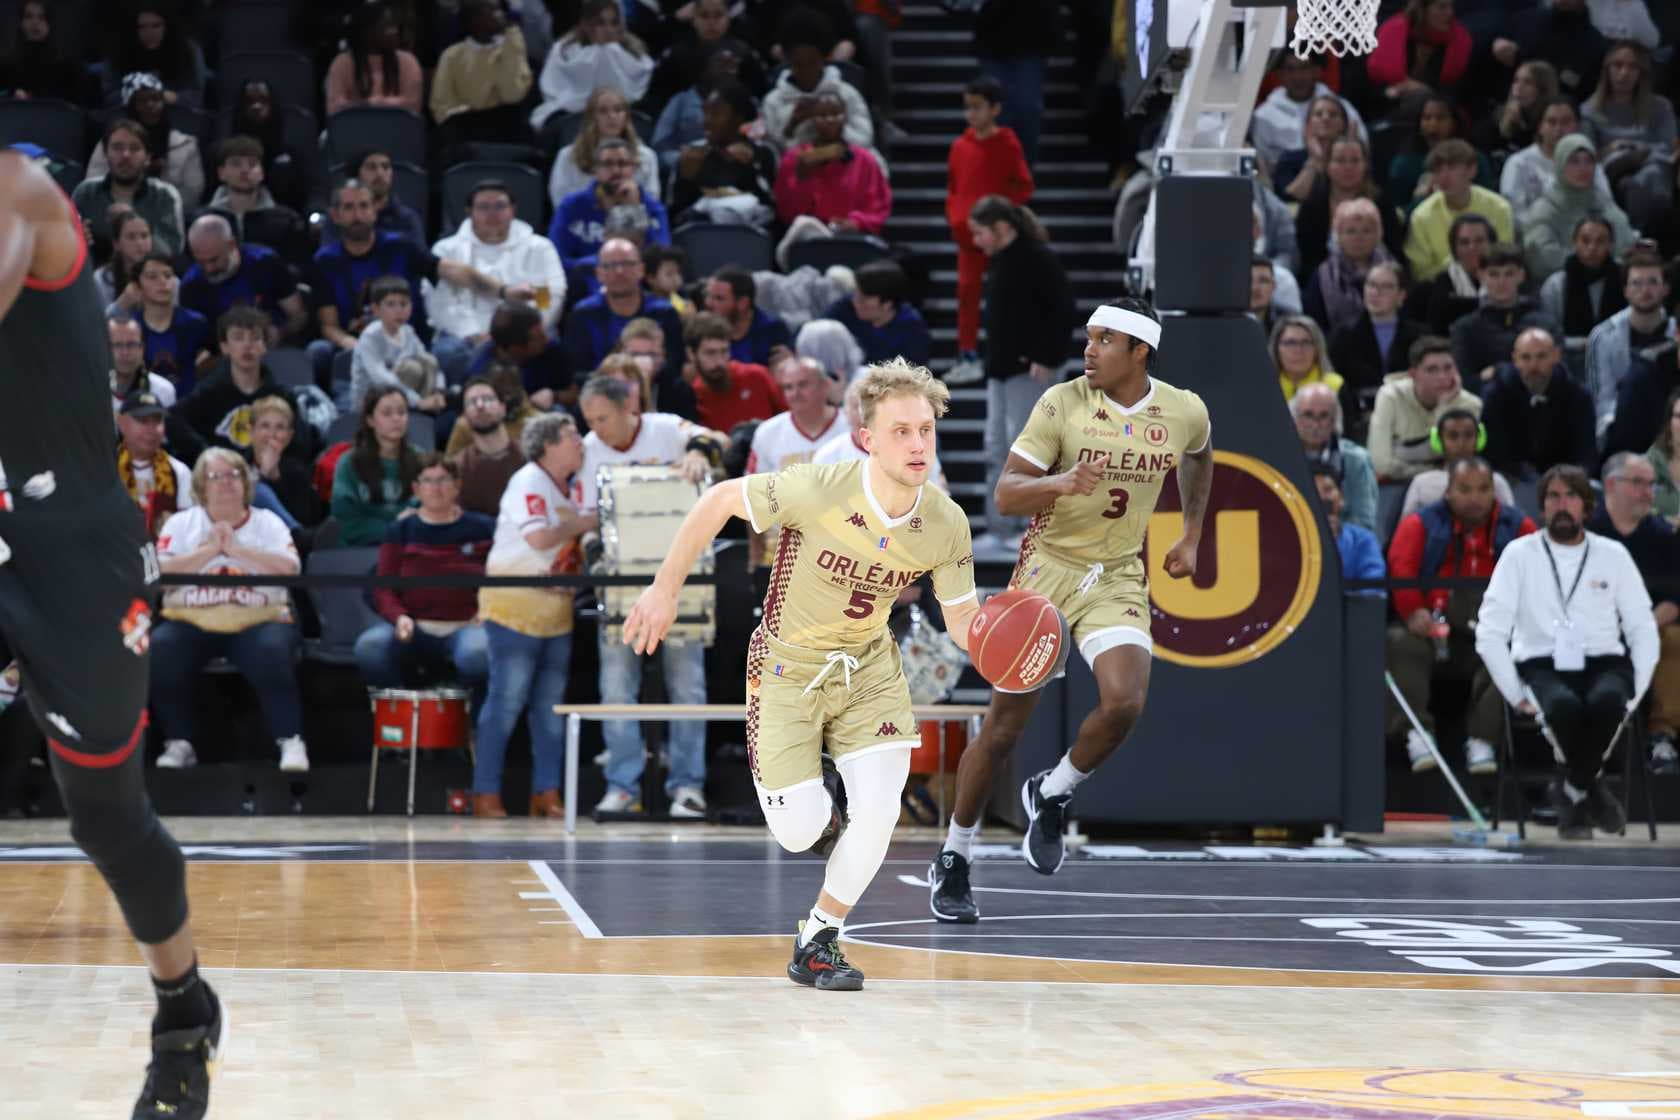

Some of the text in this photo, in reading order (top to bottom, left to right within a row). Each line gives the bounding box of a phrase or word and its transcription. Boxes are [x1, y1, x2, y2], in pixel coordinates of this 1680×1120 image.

[1099, 471, 1156, 484] ETROPOLE
[1101, 488, 1129, 519] 3
[1148, 511, 1260, 620] U
[831, 575, 890, 593] METROPOL
[843, 589, 877, 619] 5
[1023, 632, 1057, 685] LEGACY
